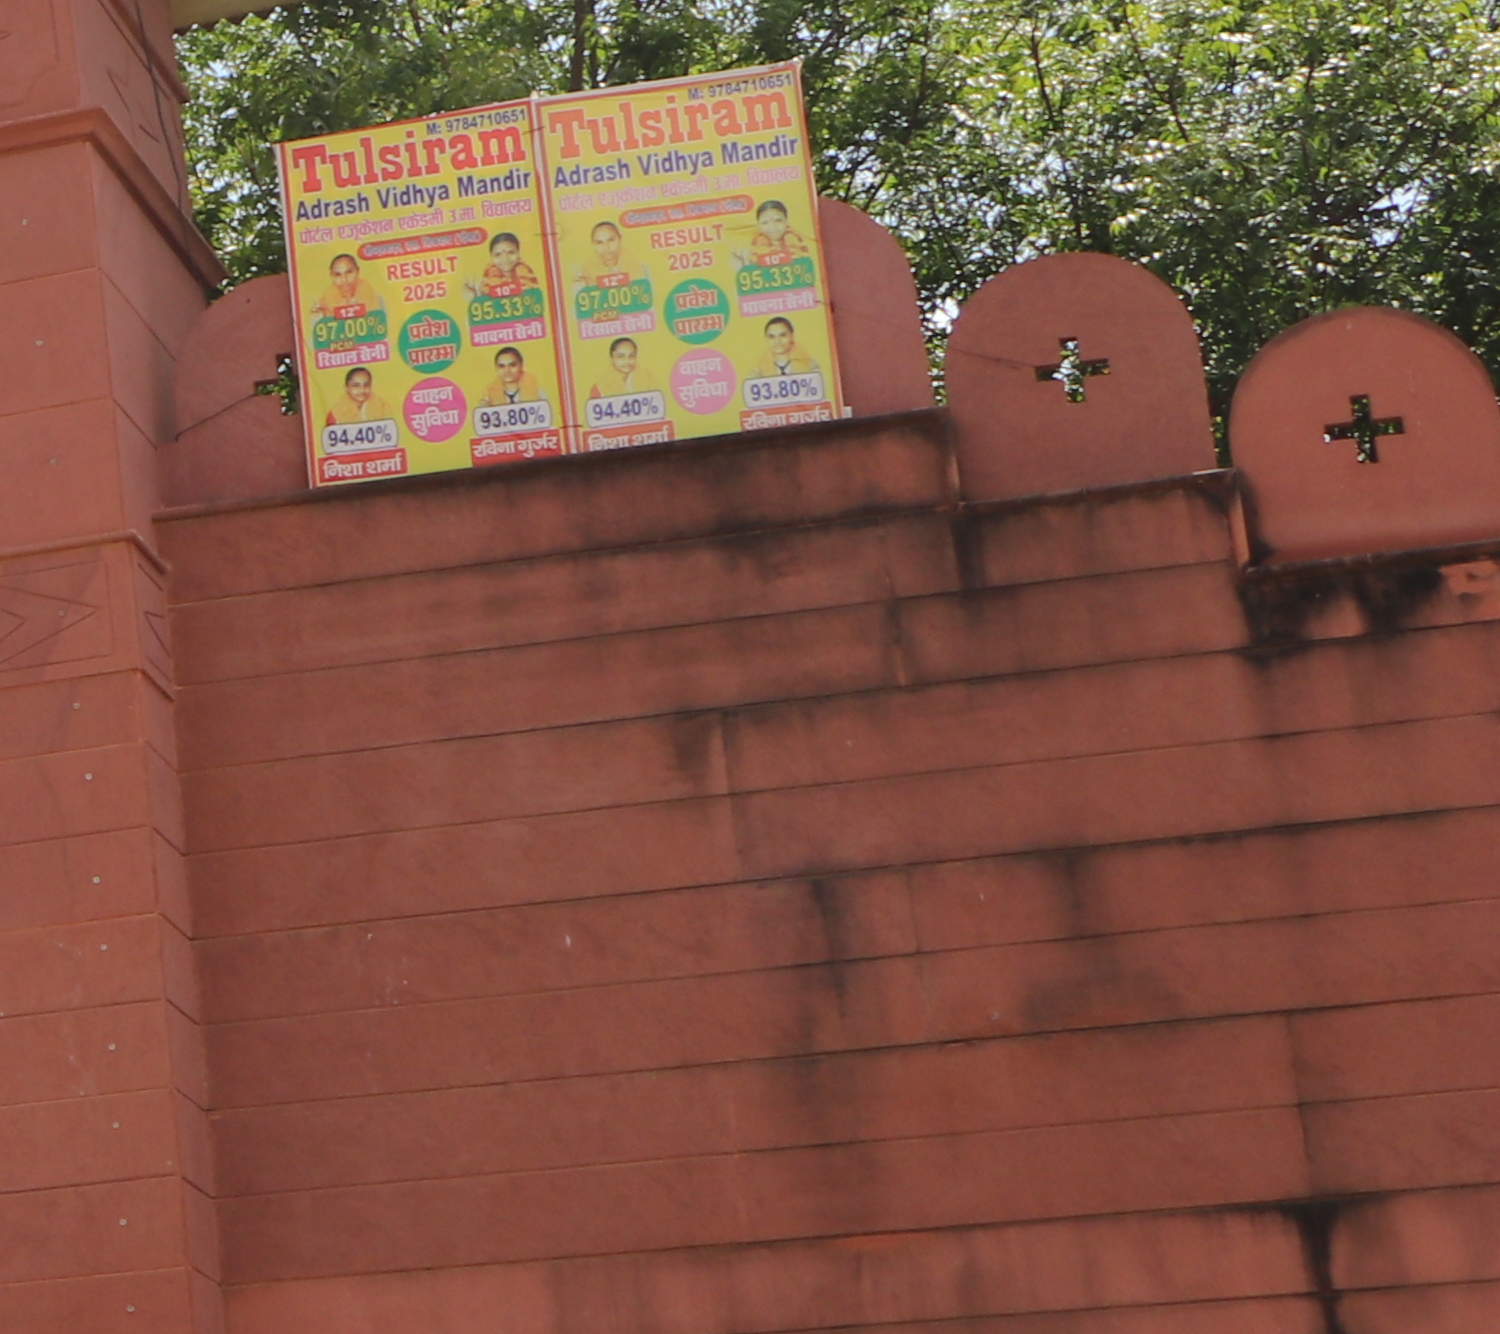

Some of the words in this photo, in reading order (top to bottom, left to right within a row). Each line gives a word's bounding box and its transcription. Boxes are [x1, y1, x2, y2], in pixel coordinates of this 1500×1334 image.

[707, 74, 792, 98] 9784710651
[445, 108, 527, 133] 9784710651
[548, 88, 793, 160] Tulsiram
[291, 123, 527, 194] Tulsiram
[554, 158, 630, 188] Adrash
[636, 149, 714, 176] Vidhya
[720, 133, 798, 165] Mandir
[296, 192, 369, 221] Adrash
[375, 183, 449, 209] Vidhya
[456, 167, 532, 198] Mandir
[649, 223, 723, 249] RESULT
[385, 255, 457, 281] RESULT
[666, 250, 713, 272] 2025
[737, 263, 811, 291] 95.33%
[401, 281, 446, 303] 2025
[577, 284, 649, 312] 97.00%
[470, 294, 541, 322] 95.33%
[315, 315, 384, 342] 97.00%
[748, 375, 816, 402] 93.80%
[479, 404, 545, 430] 93.80%
[591, 396, 657, 422] 94.40%
[328, 423, 391, 449] 94.40%
